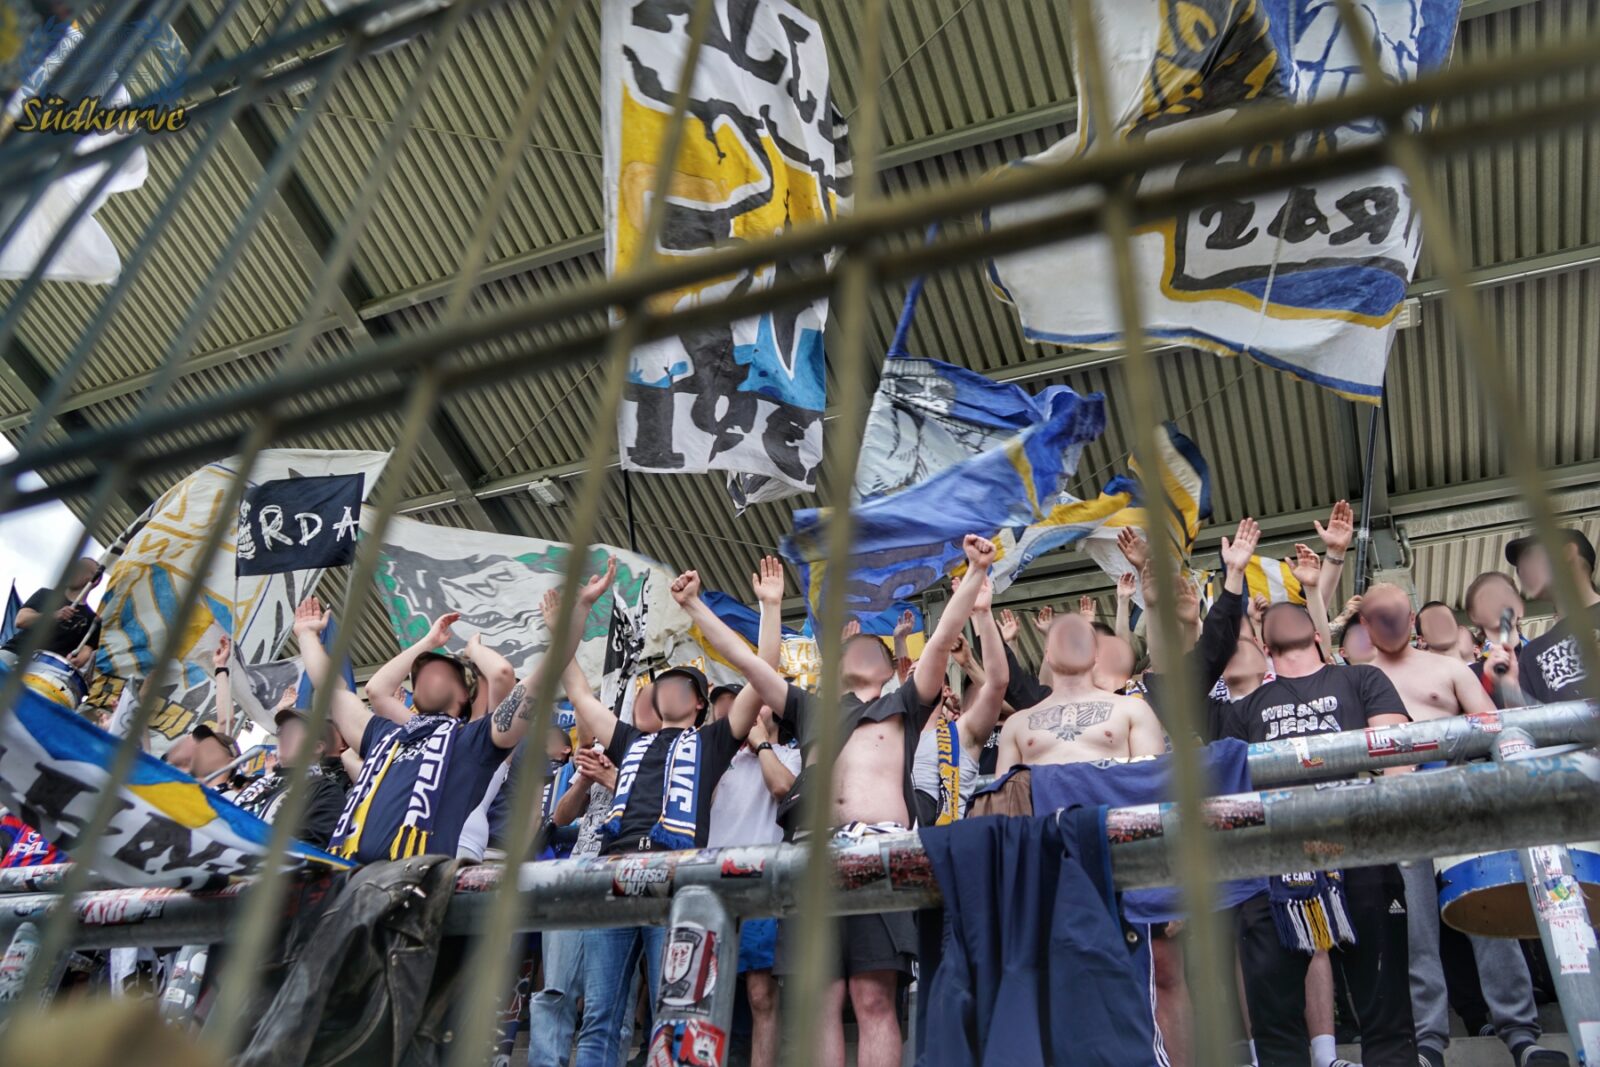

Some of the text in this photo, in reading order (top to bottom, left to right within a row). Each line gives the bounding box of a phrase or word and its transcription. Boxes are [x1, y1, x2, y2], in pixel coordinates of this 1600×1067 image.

[1261, 695, 1338, 723] WIR SIND
[1265, 714, 1342, 741] JENA
